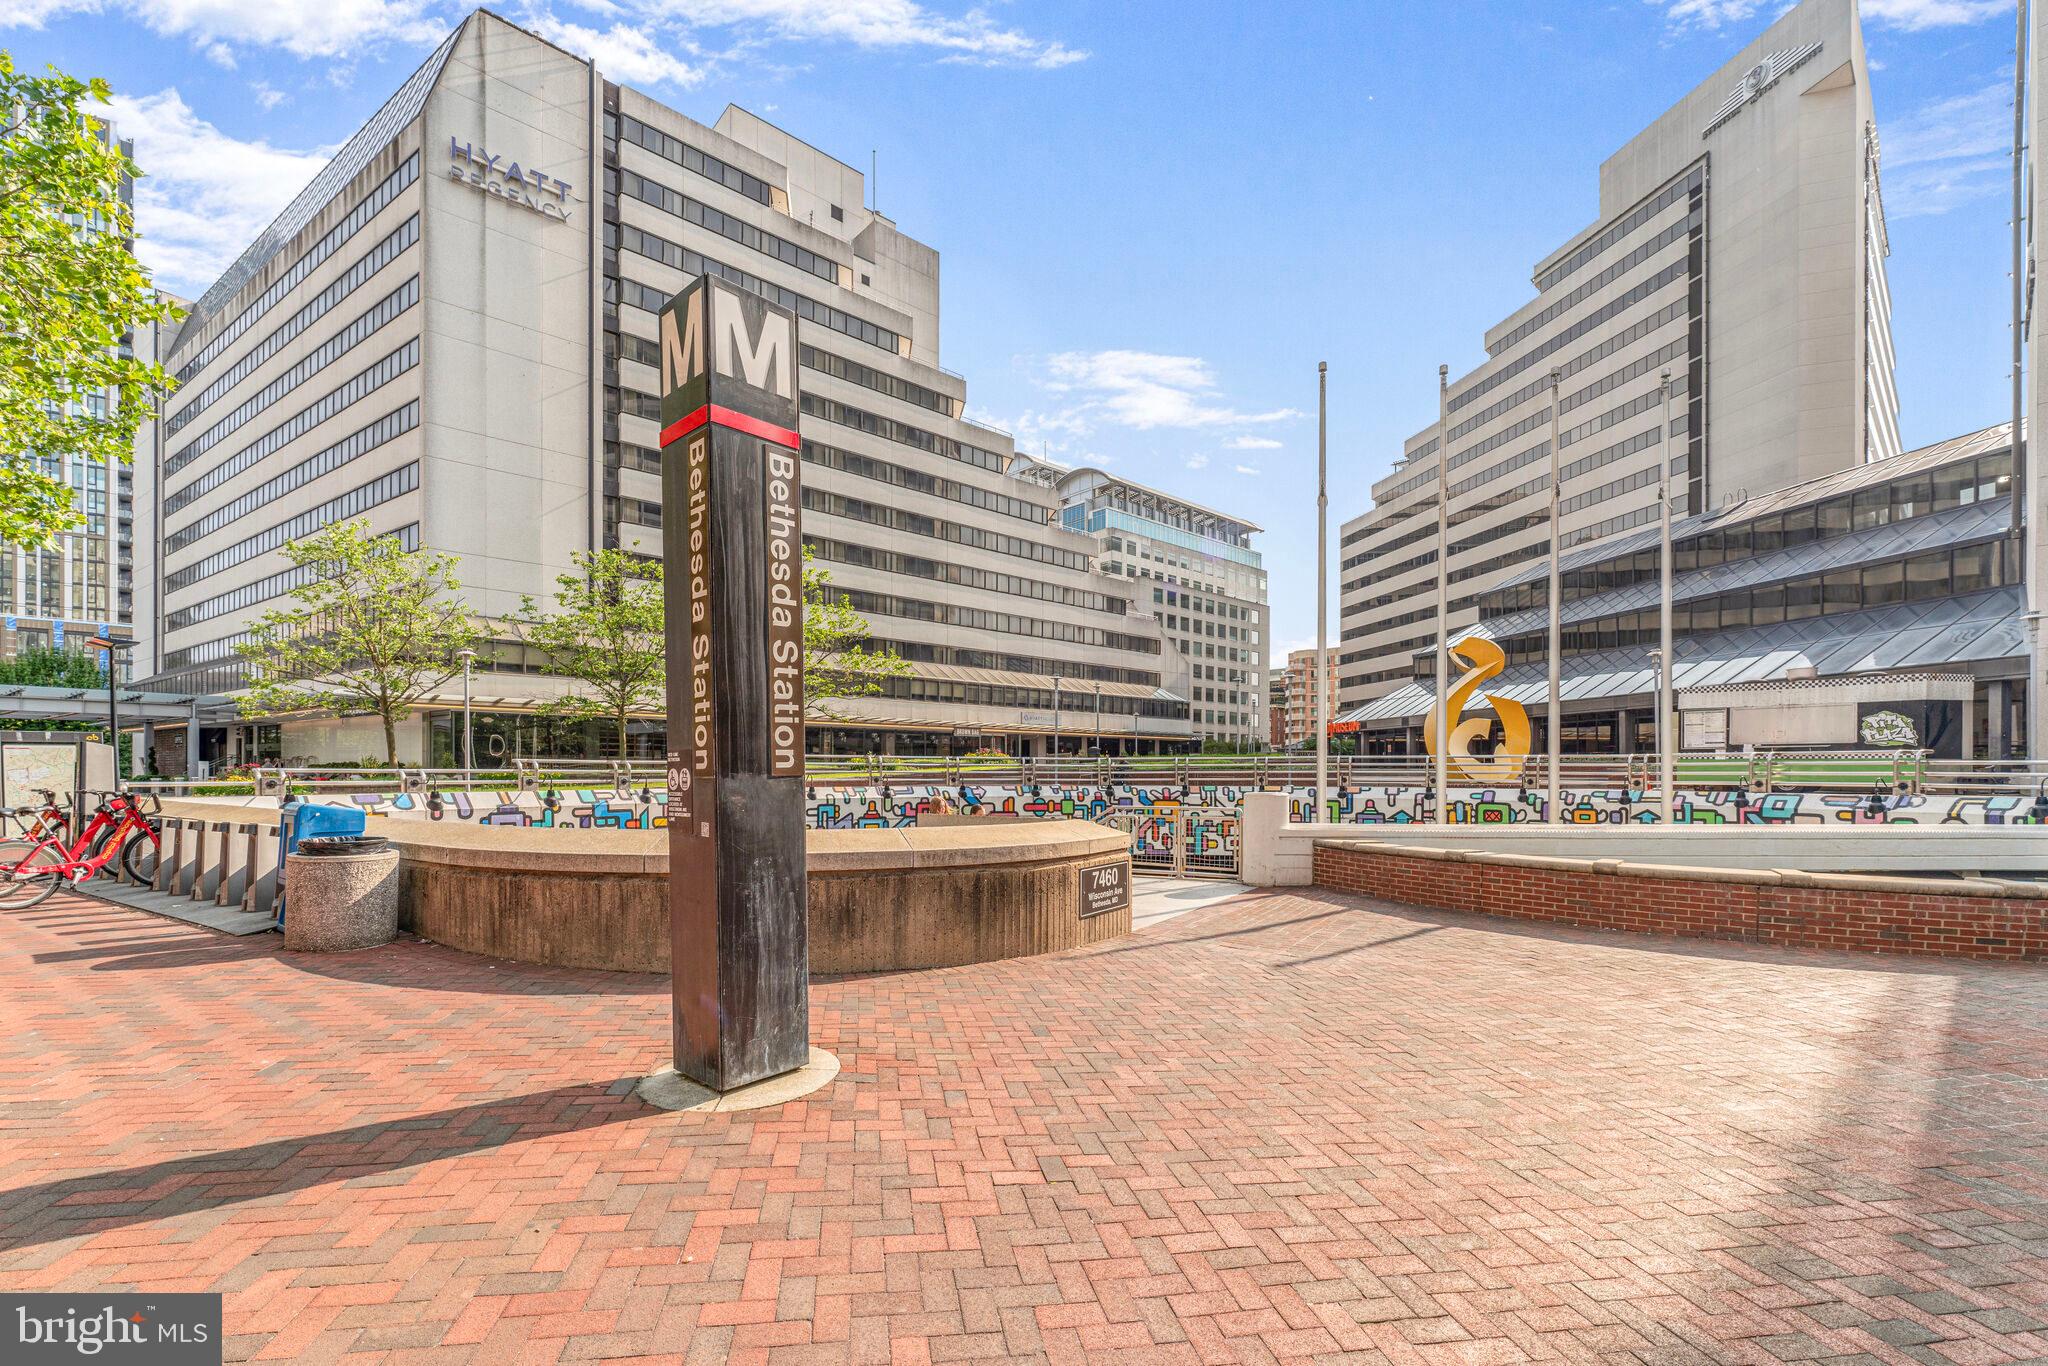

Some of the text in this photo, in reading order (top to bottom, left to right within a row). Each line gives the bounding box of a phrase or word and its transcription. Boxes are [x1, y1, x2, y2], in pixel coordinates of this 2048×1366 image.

[450, 165, 572, 224] REGENCY
[451, 136, 572, 202] HYATT
[661, 287, 704, 398] M
[714, 286, 792, 400] M
[690, 437, 710, 770] Bethesda Station
[769, 452, 799, 769] Bethesda Station
[1088, 889, 1113, 900] Wisconsin
[1092, 868, 1118, 889] 7460
